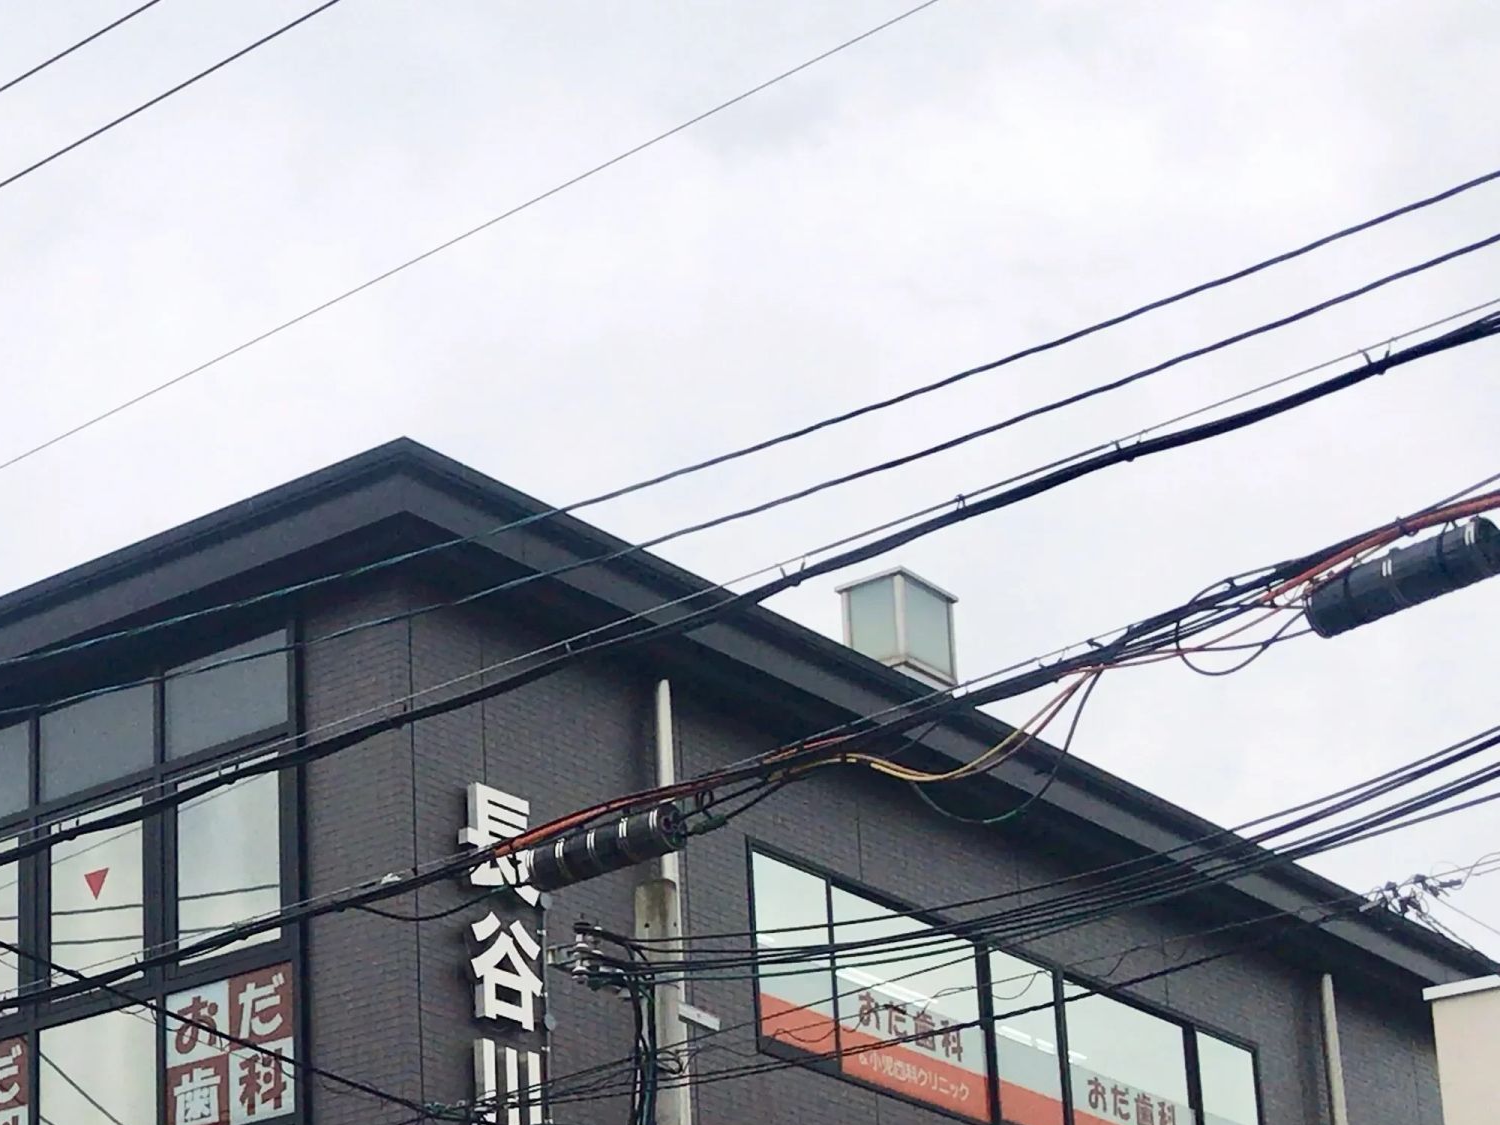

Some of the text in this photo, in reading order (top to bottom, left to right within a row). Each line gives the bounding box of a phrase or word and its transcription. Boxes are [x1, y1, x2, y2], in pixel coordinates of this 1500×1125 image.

[174, 973, 285, 1054] おだ
[858, 991, 964, 1063] おだ歯科
